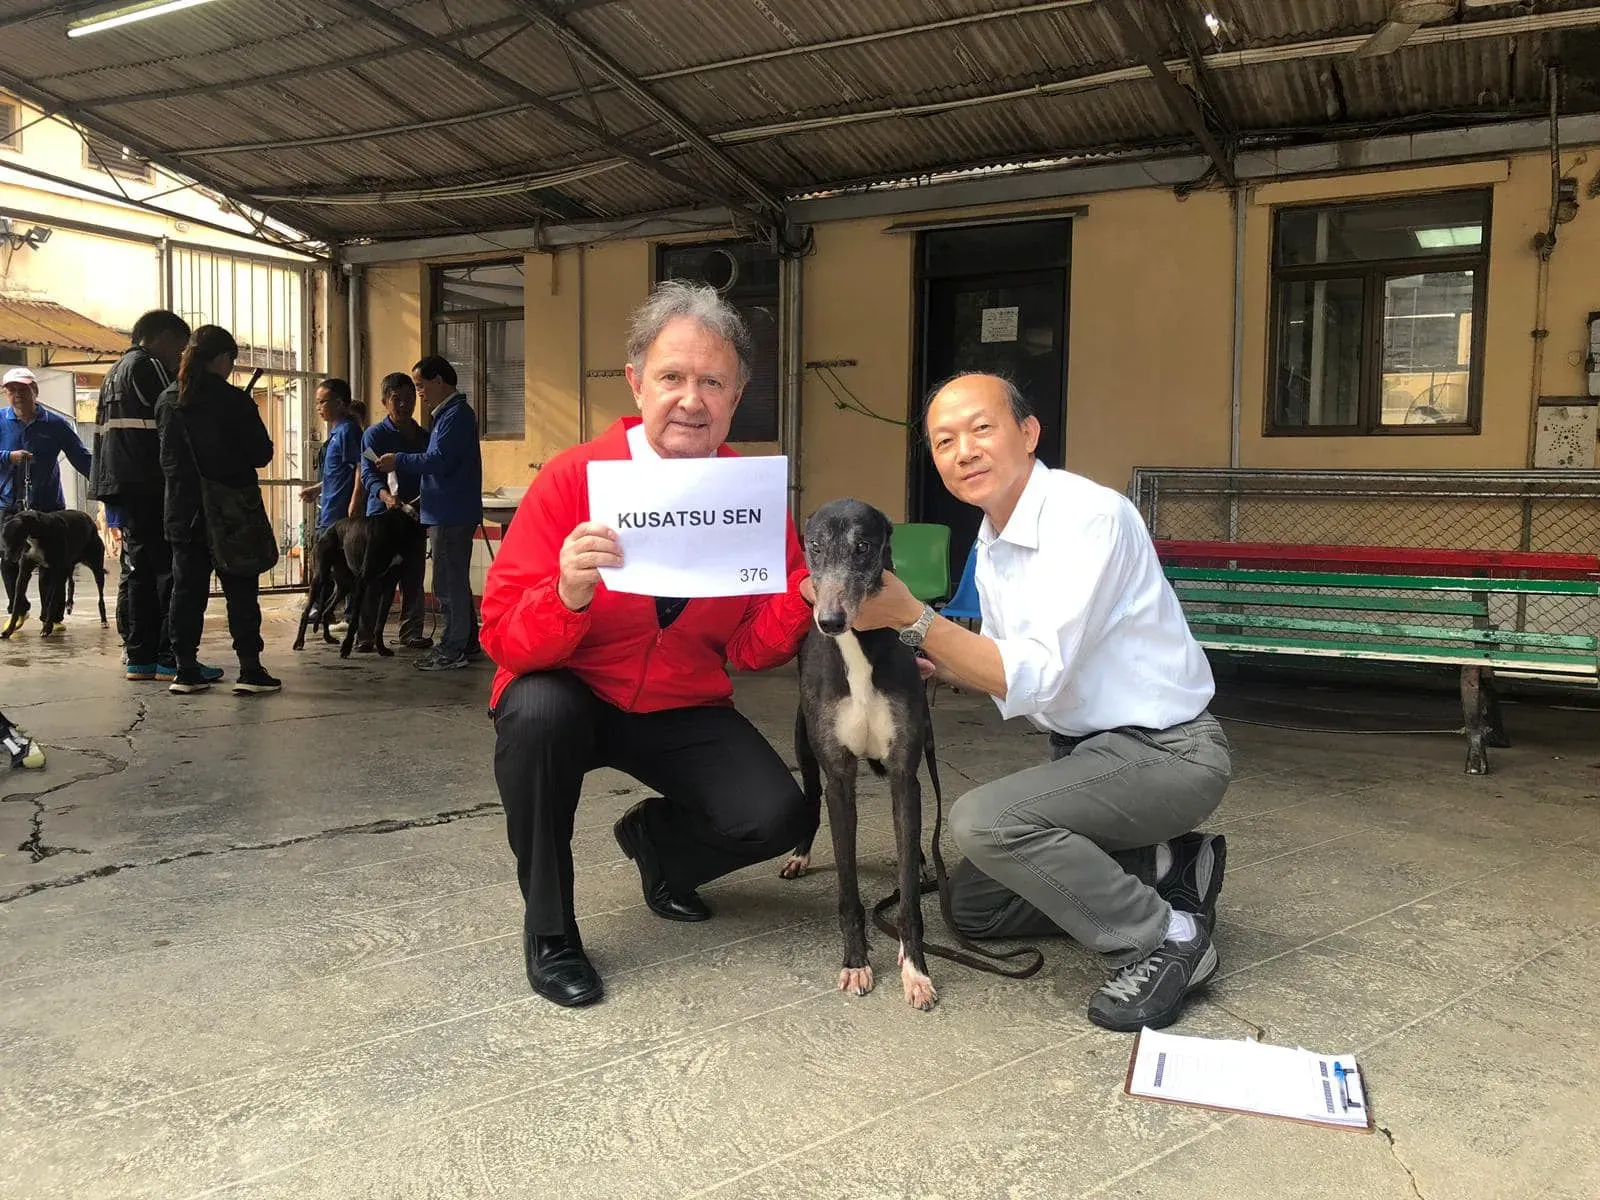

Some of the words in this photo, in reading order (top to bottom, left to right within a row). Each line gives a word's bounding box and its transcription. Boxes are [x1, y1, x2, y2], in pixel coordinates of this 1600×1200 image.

[618, 510, 716, 528] KUSATSU
[722, 508, 762, 525] SEN
[740, 567, 768, 582] 376
